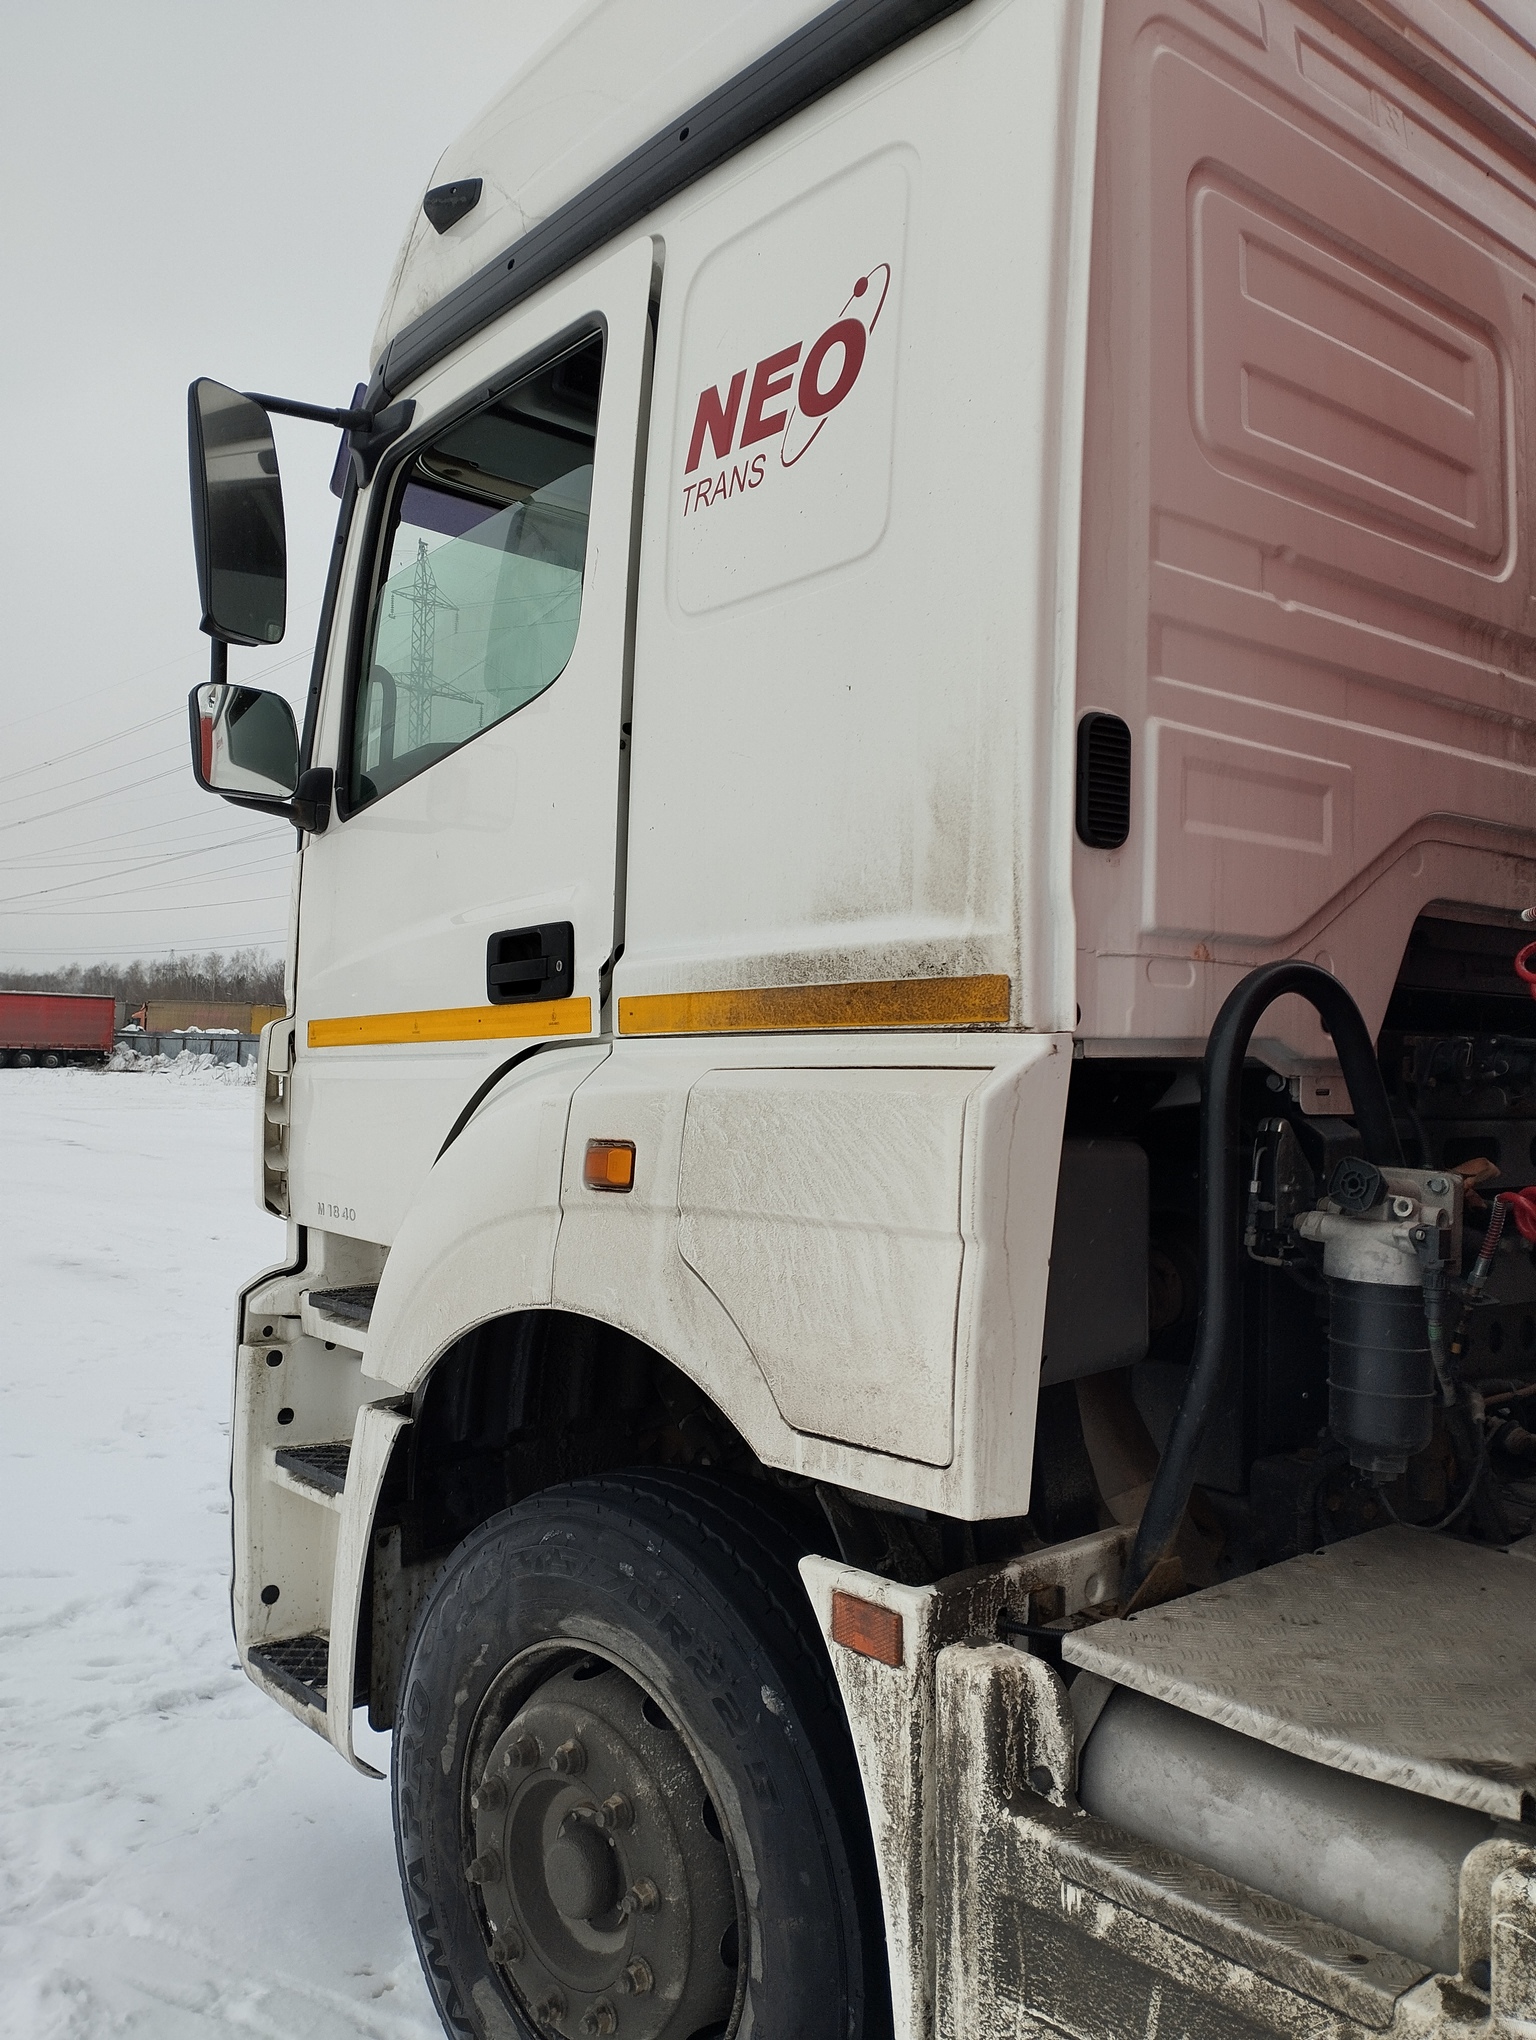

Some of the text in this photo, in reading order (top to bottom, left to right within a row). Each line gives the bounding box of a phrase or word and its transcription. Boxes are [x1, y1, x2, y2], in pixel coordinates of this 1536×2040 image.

[684, 317, 867, 476] NEO
[683, 453, 767, 517] TRANS
[328, 1204, 357, 1222] 1840
[407, 1856, 479, 2040] AMA
